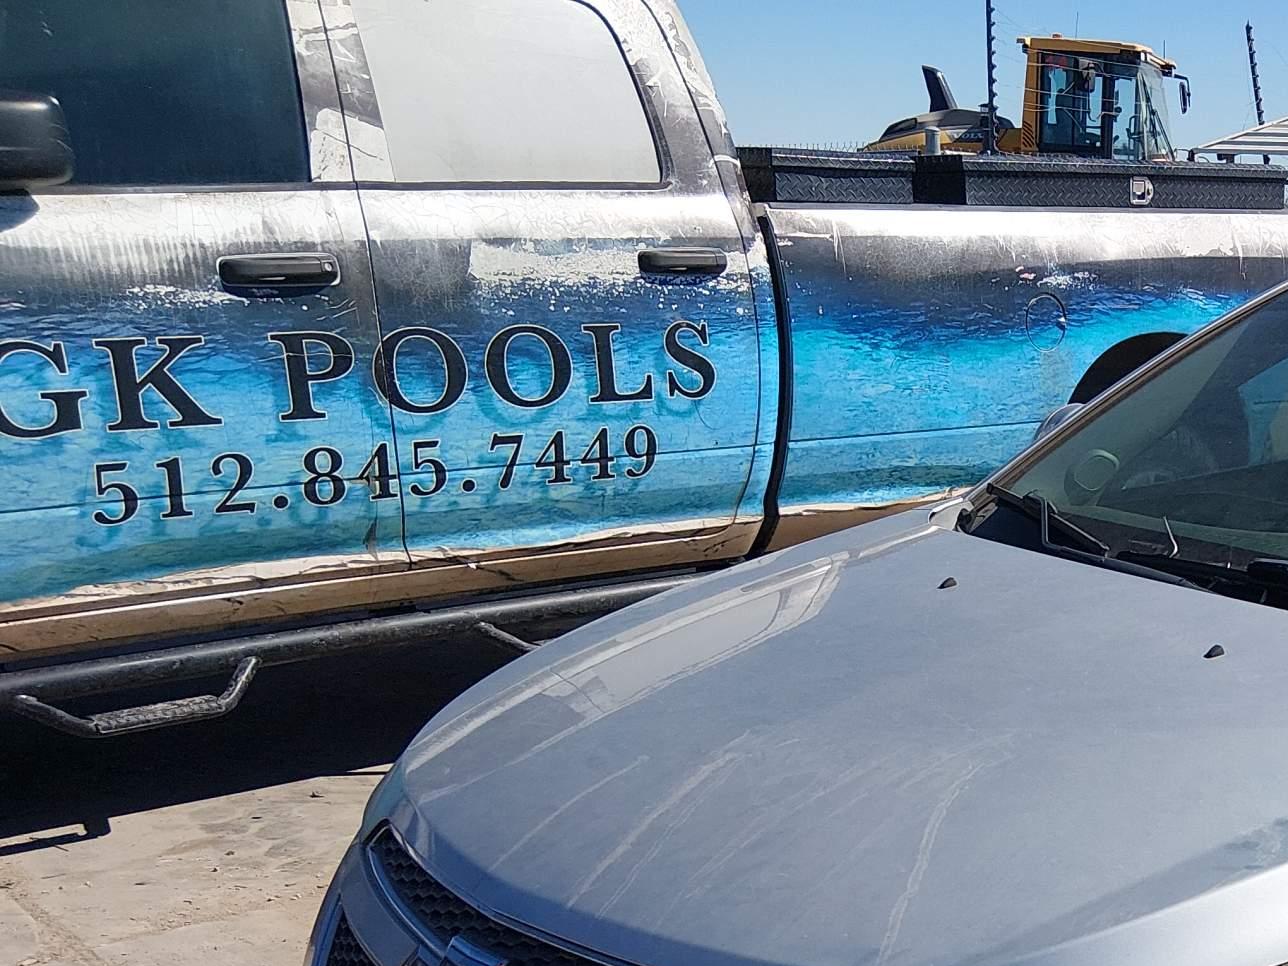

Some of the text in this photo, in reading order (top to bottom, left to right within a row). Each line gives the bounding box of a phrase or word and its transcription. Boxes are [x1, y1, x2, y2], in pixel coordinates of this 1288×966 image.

[0, 320, 718, 439] GK POOLS
[91, 423, 659, 527] 512.845.7449
